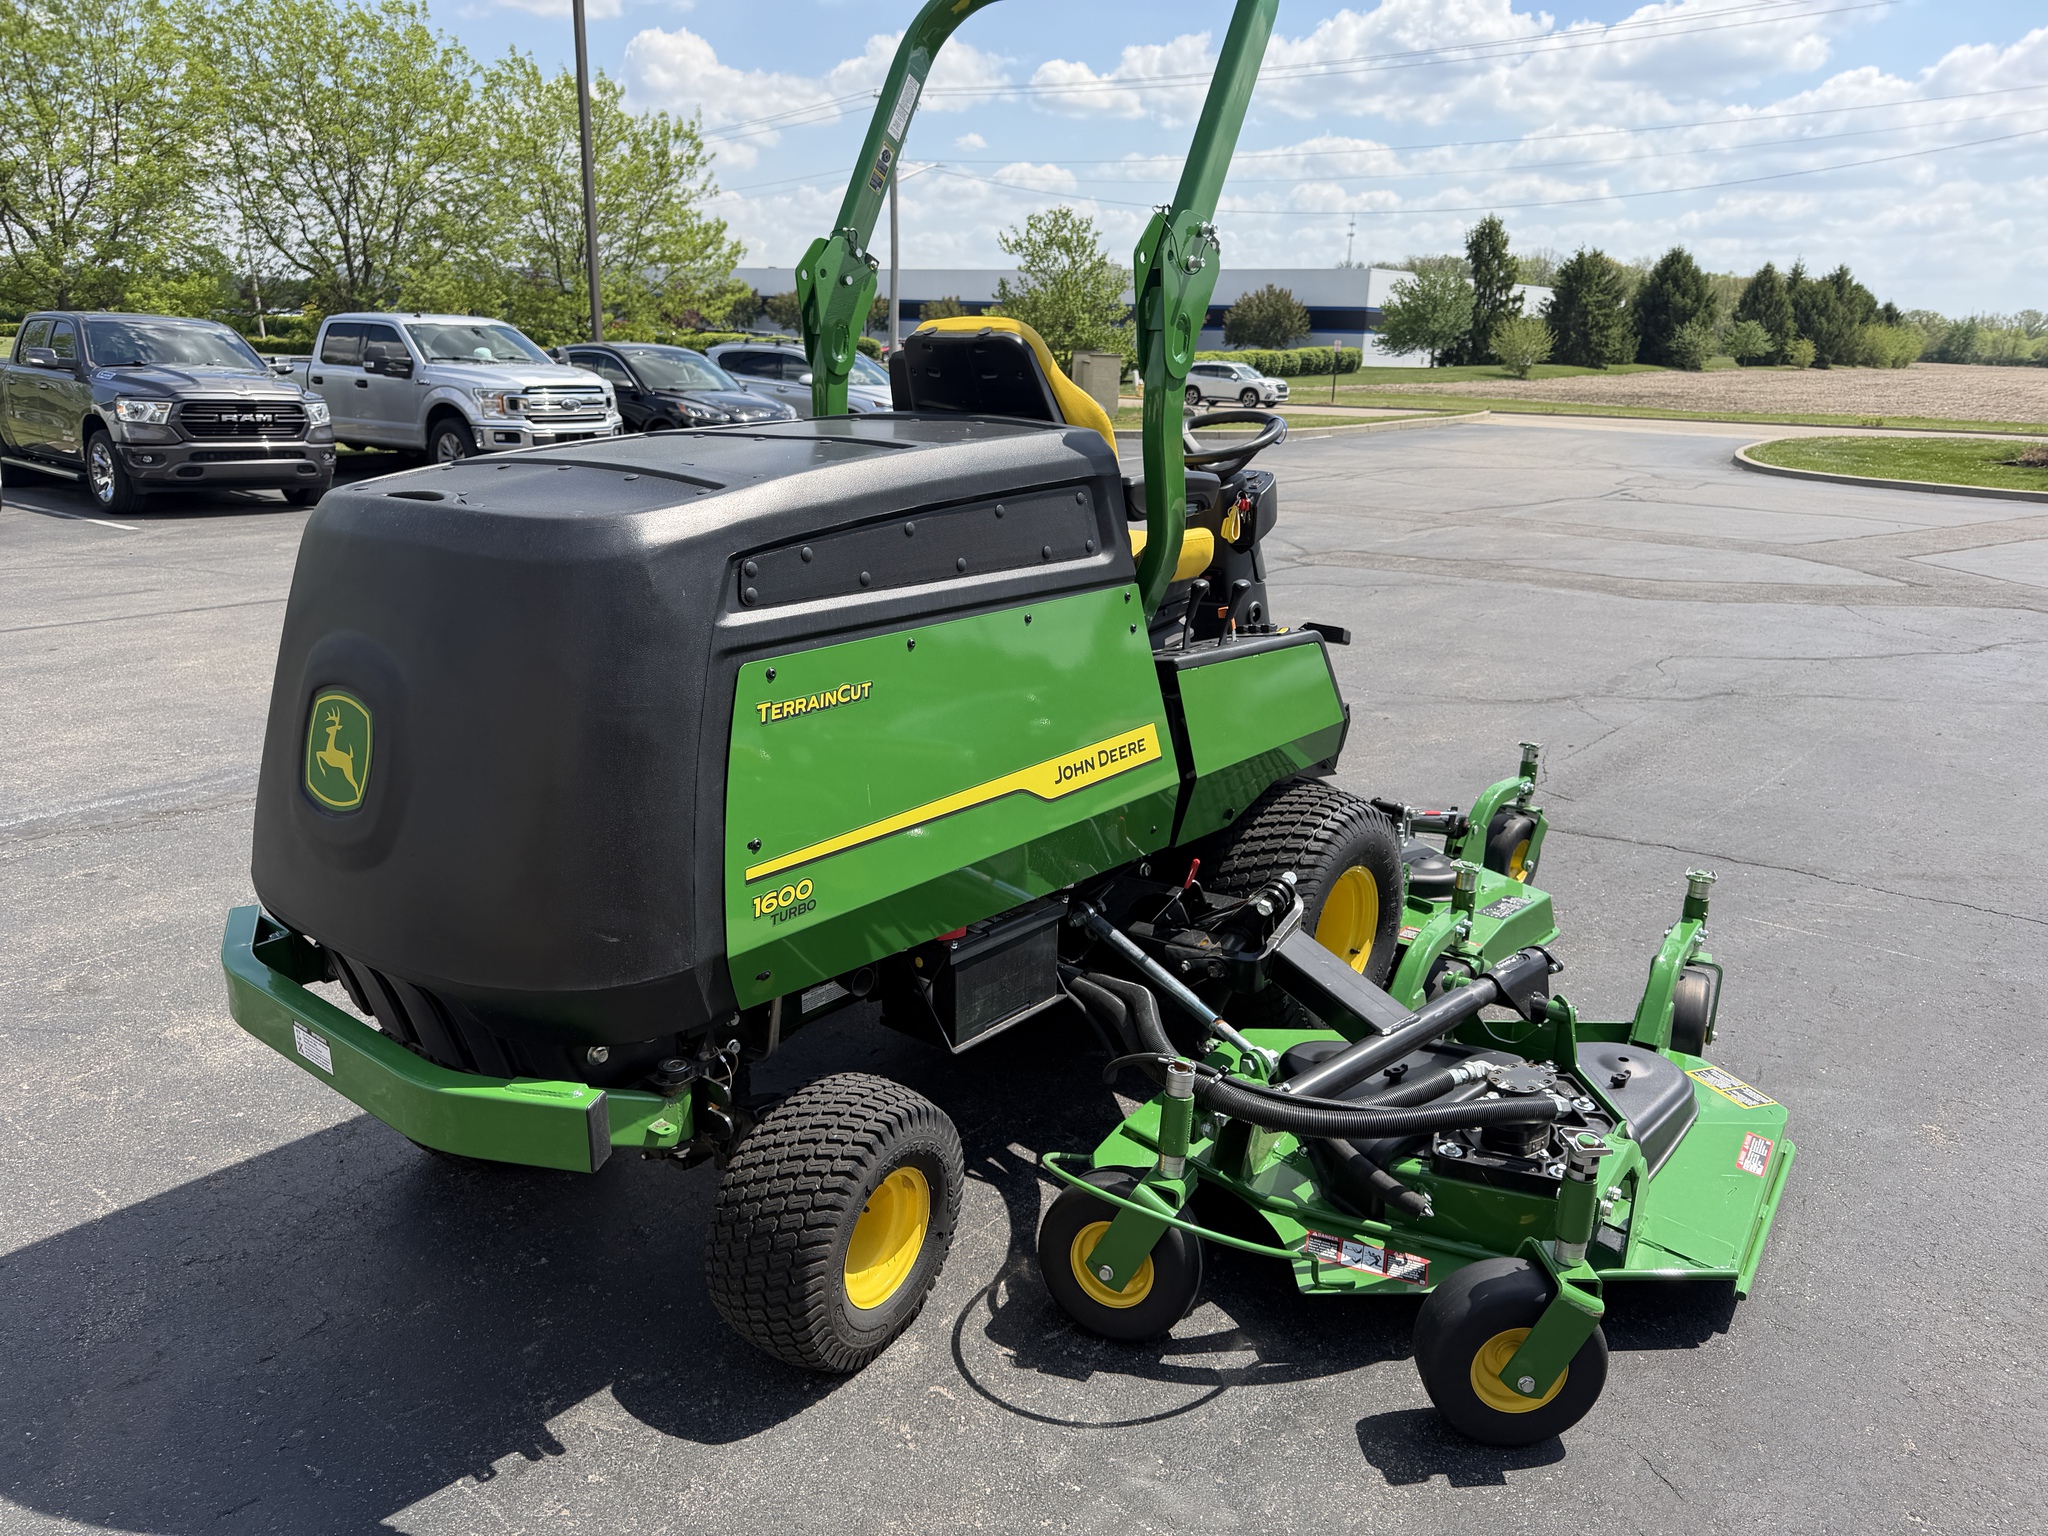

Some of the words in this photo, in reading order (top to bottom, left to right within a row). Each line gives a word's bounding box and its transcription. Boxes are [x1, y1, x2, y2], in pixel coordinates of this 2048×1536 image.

[221, 413, 273, 422] RAM
[753, 878, 814, 919] 1600
[771, 899, 817, 926] TURBO
